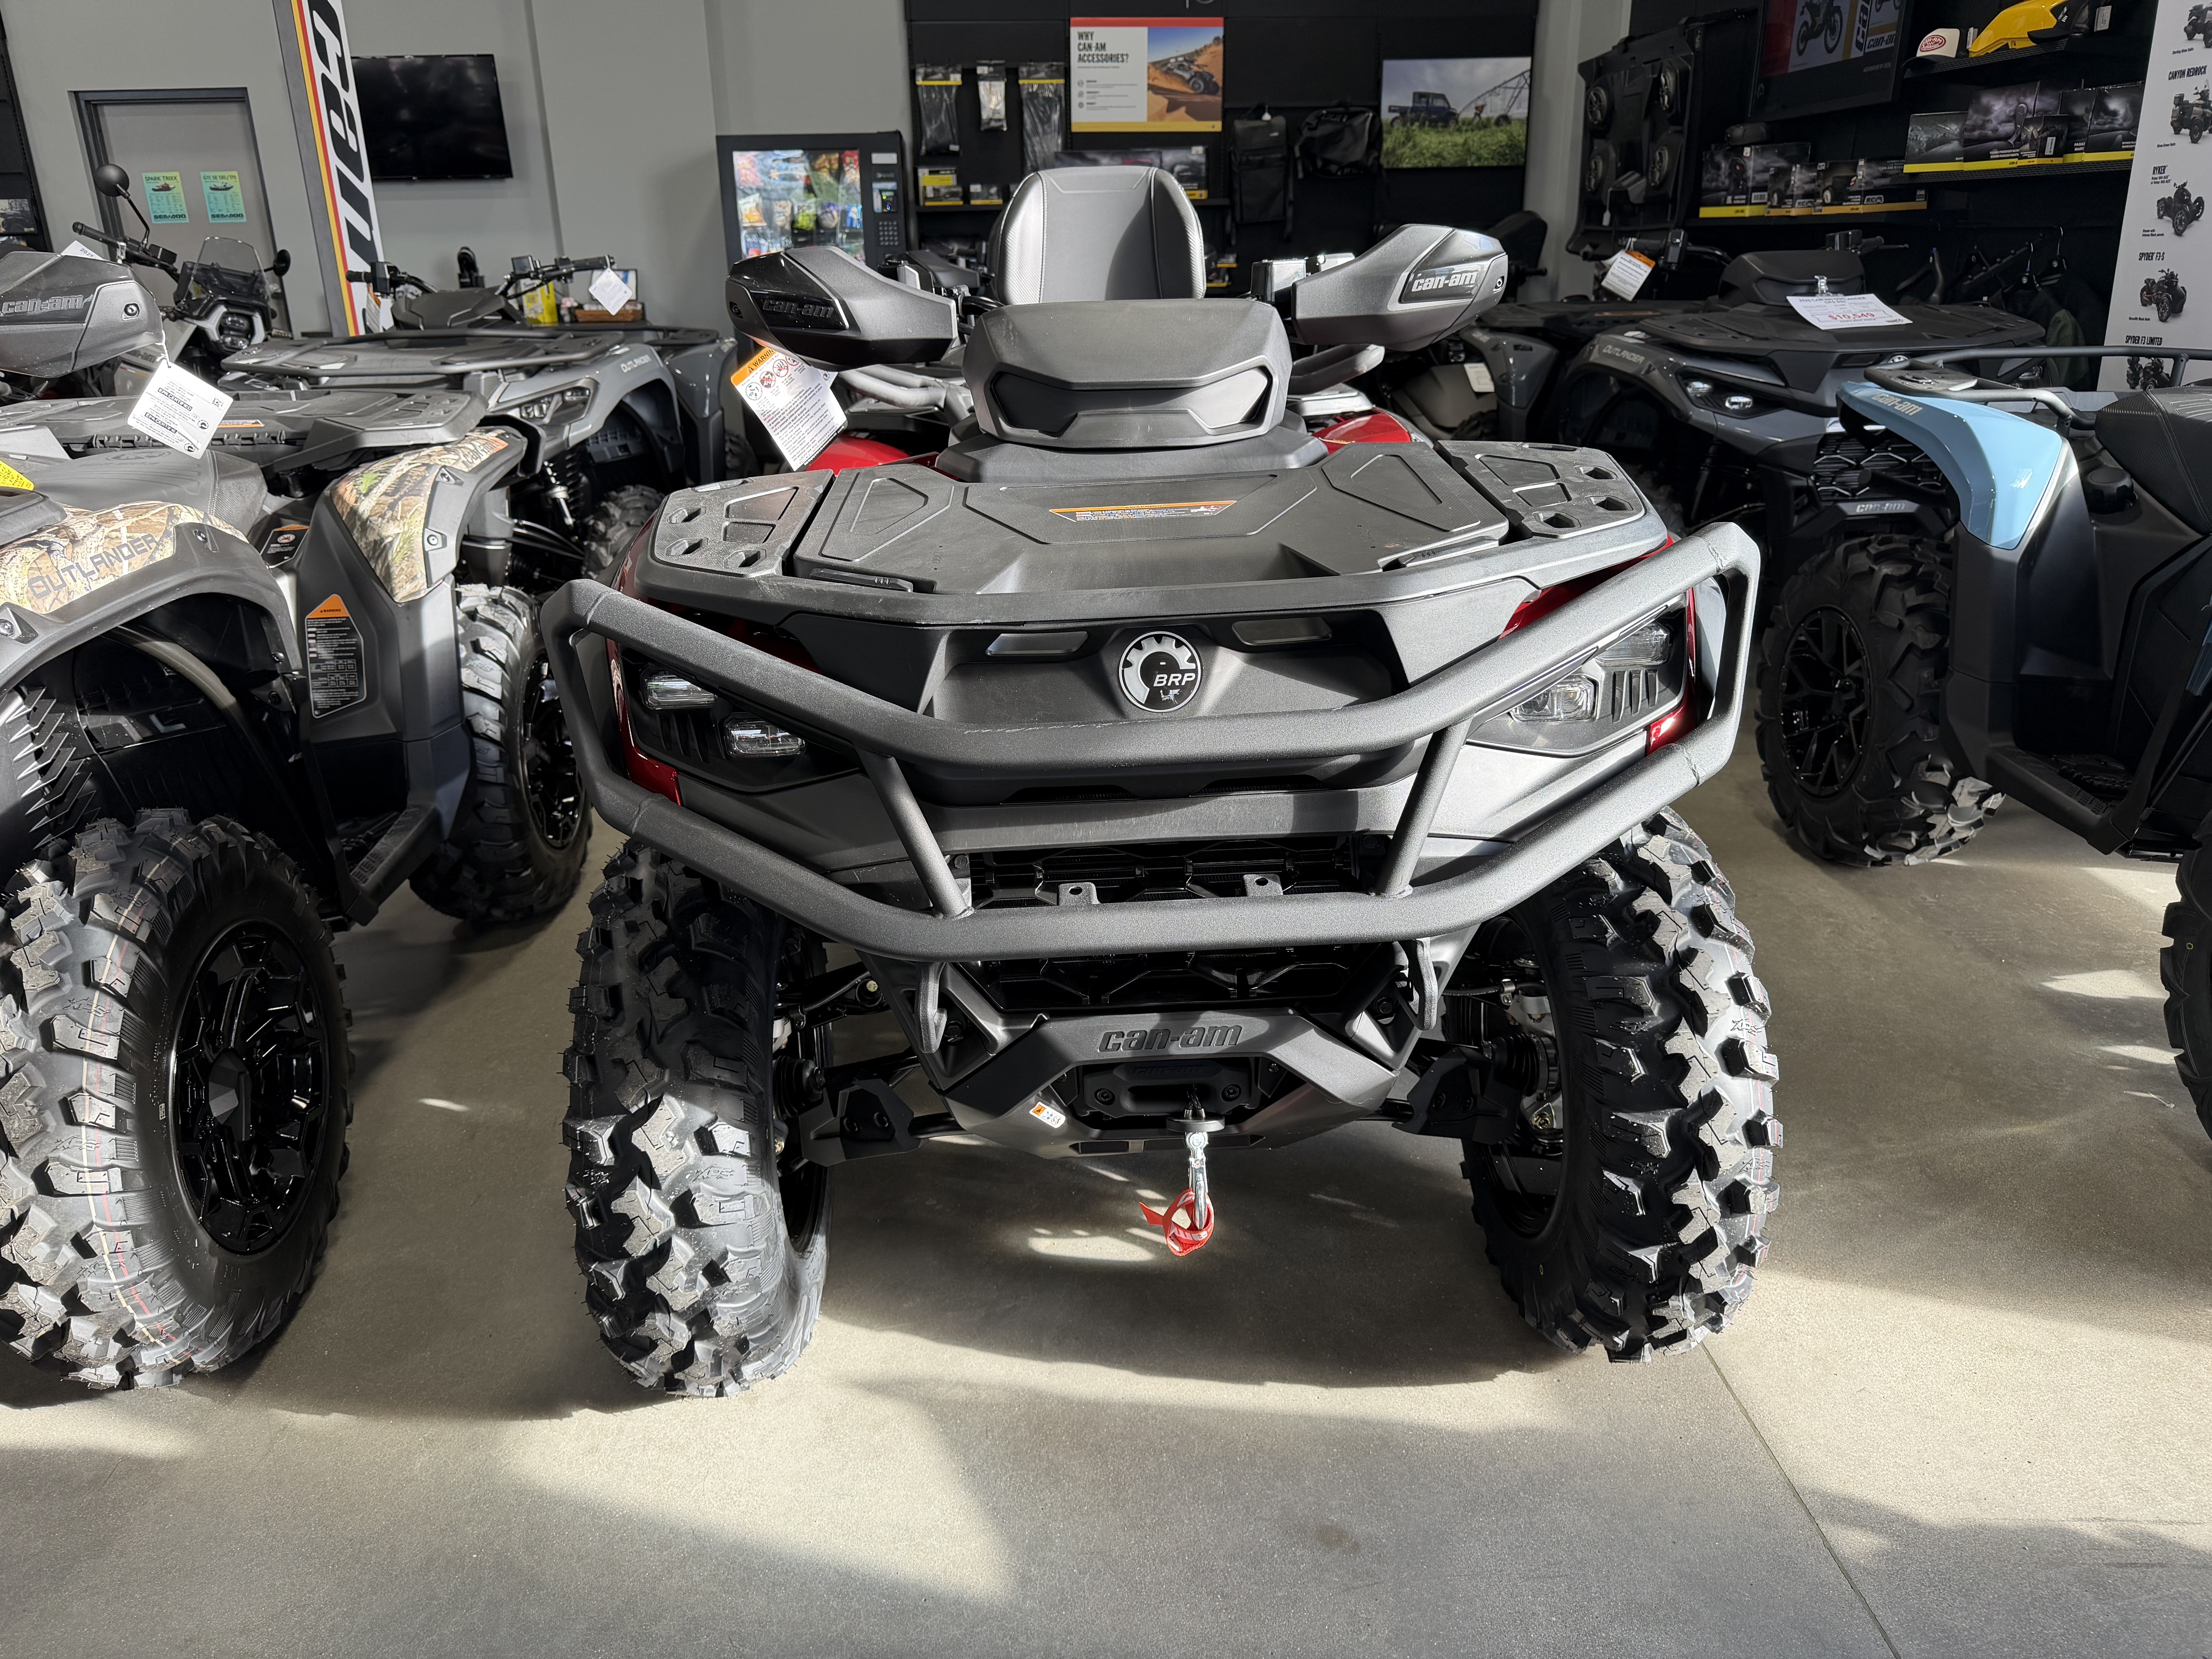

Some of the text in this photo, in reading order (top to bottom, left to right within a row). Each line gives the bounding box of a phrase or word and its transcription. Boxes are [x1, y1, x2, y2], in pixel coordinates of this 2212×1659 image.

[1077, 31, 1094, 41] WHY
[1077, 53, 1129, 63] ACCESSORIES?
[2168, 65, 2207, 80] CANYON REDROCK
[2152, 165, 2166, 175] RYKER
[2138, 252, 2165, 261] SPYDER F3-S
[1412, 272, 1477, 292] can-am
[2, 295, 84, 313] can-am
[763, 299, 834, 318] can-am
[1828, 313, 1875, 321] $10,549
[2125, 335, 2163, 346] SPYDER F3 LIMITED
[752, 349, 775, 367] WARNIN
[1871, 393, 1923, 416] can-am
[1856, 503, 1906, 513] can-am
[28, 534, 157, 599] OUTLANDER
[1153, 672, 1196, 687] BRP
[1097, 1025, 1243, 1053] can-am
